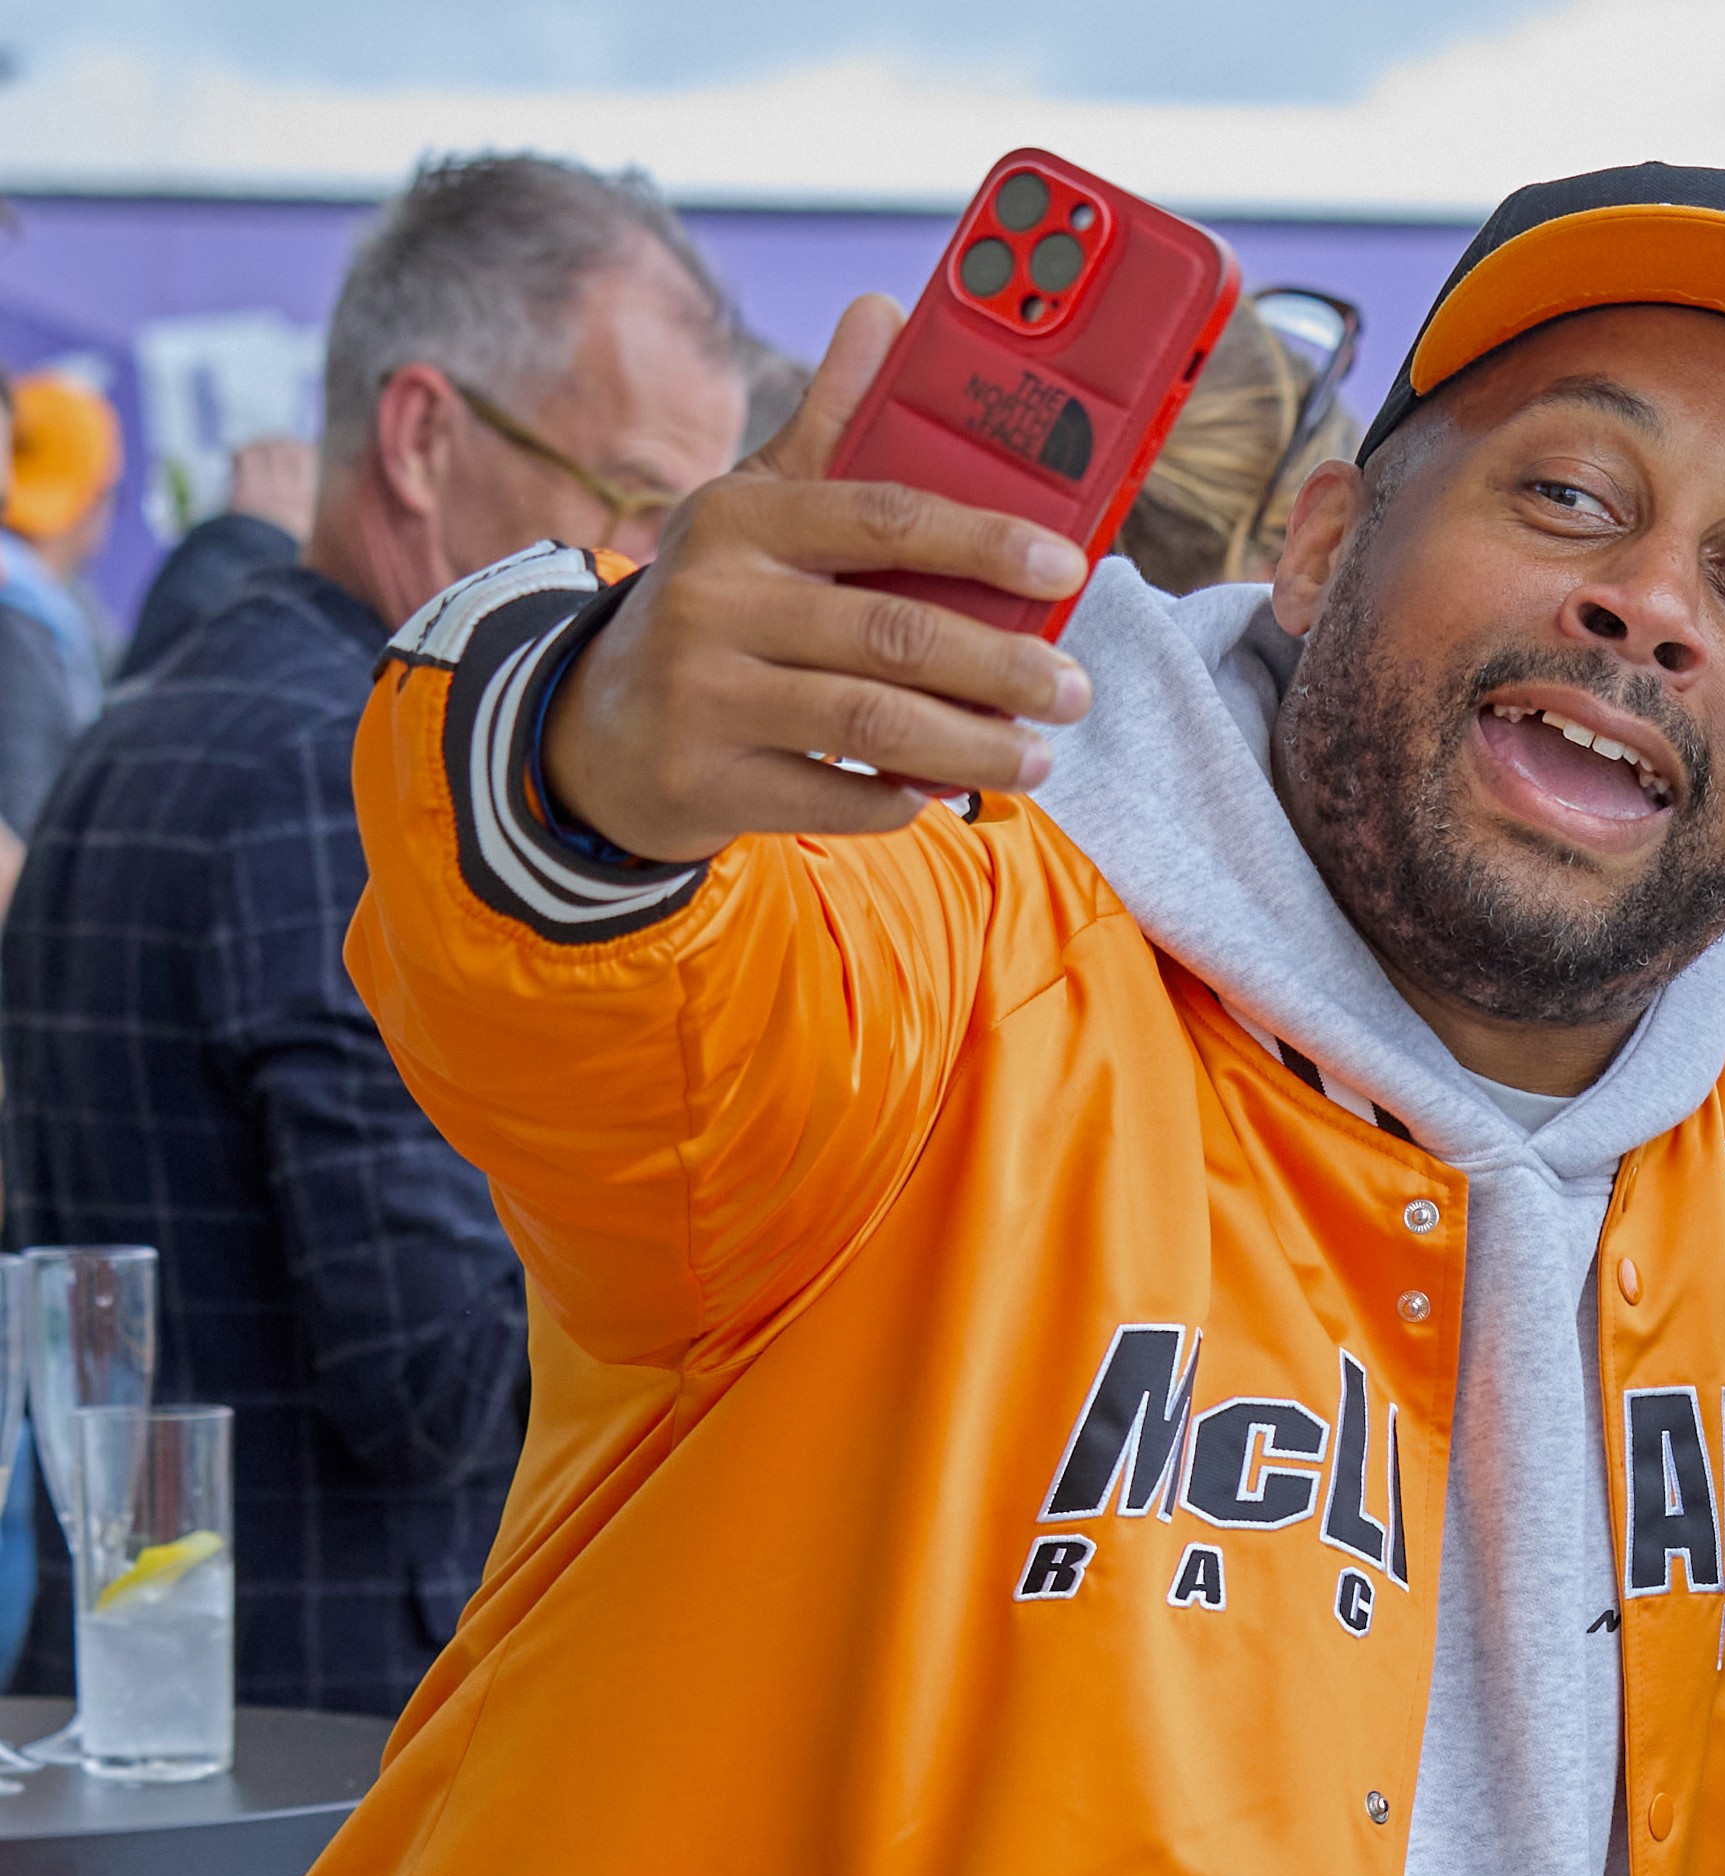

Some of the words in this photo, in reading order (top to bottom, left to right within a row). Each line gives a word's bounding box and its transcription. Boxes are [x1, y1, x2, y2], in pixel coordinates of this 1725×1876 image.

[964, 374, 1052, 434] NORTH
[1020, 370, 1065, 411] THE
[981, 408, 1042, 459] FACE
